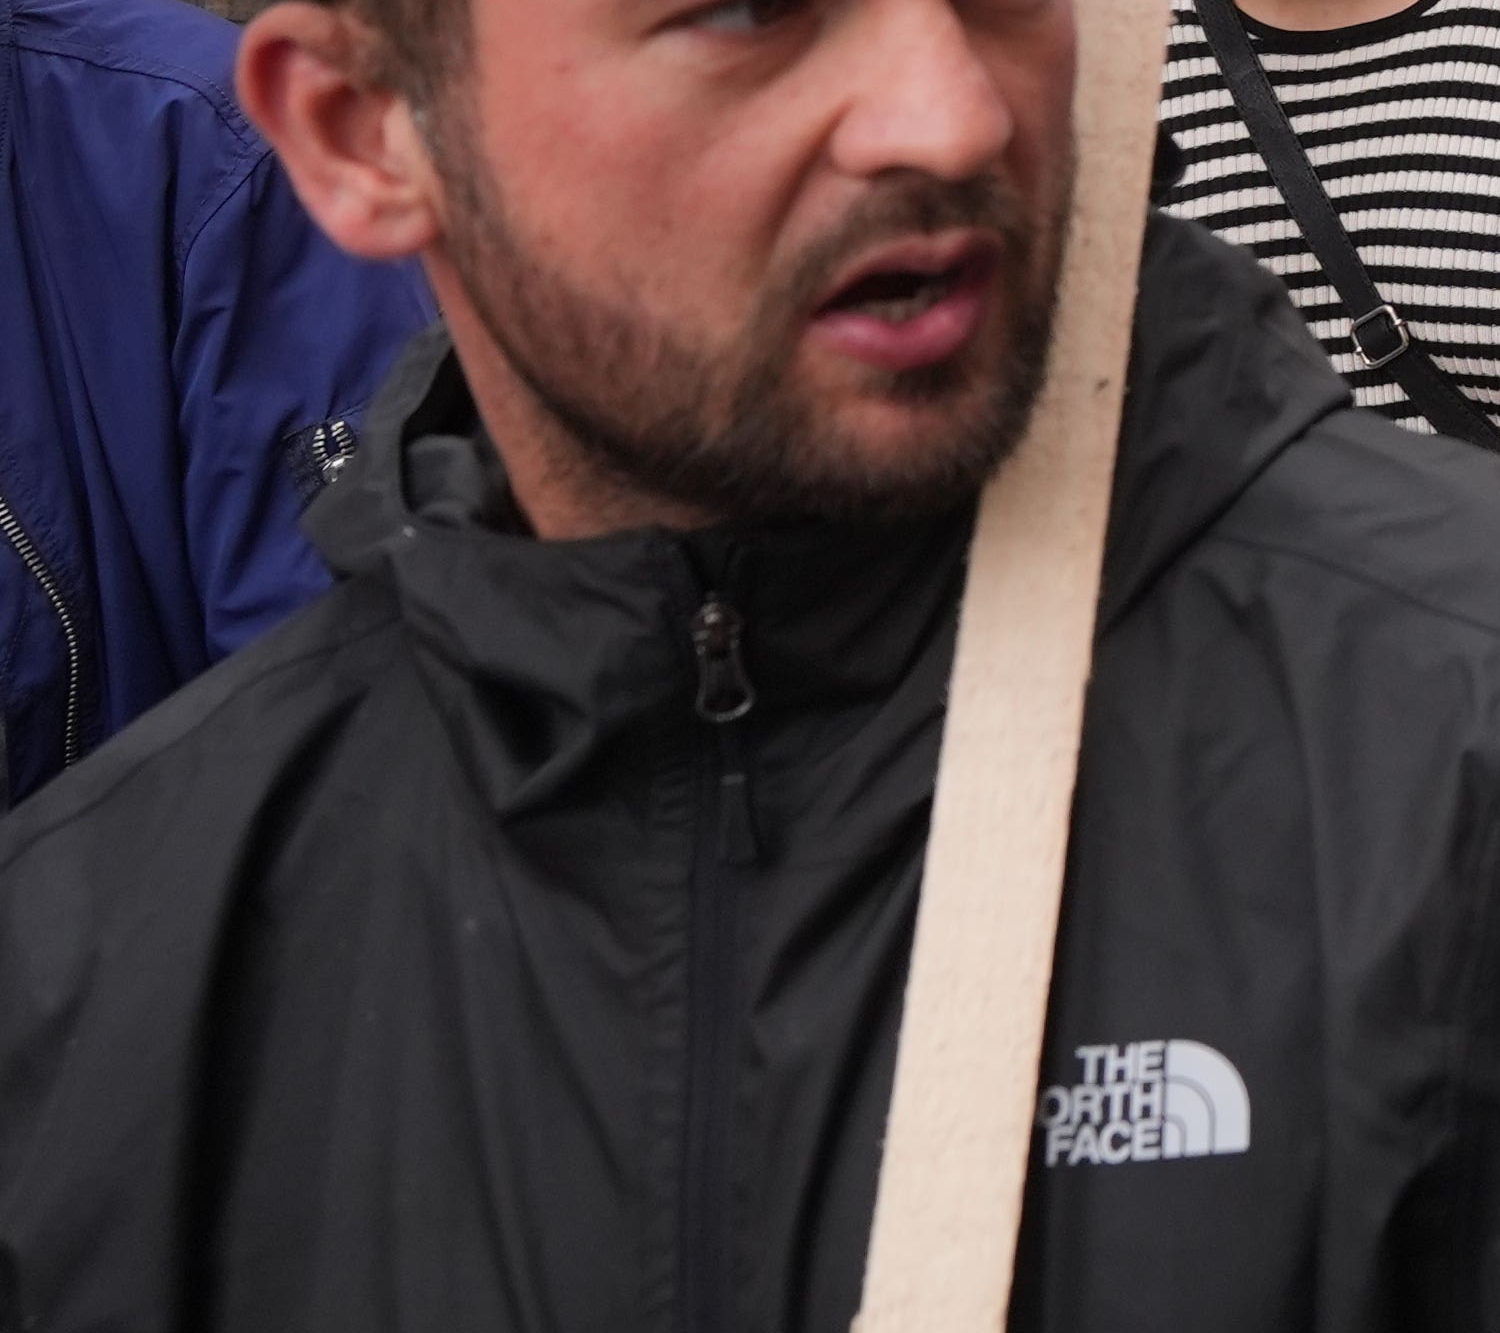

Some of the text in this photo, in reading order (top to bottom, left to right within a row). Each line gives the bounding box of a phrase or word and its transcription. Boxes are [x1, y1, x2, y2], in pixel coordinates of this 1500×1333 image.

[1075, 1041, 1166, 1083] THE
[1043, 1083, 1161, 1125] ORTH
[1046, 1120, 1162, 1166] FACE
